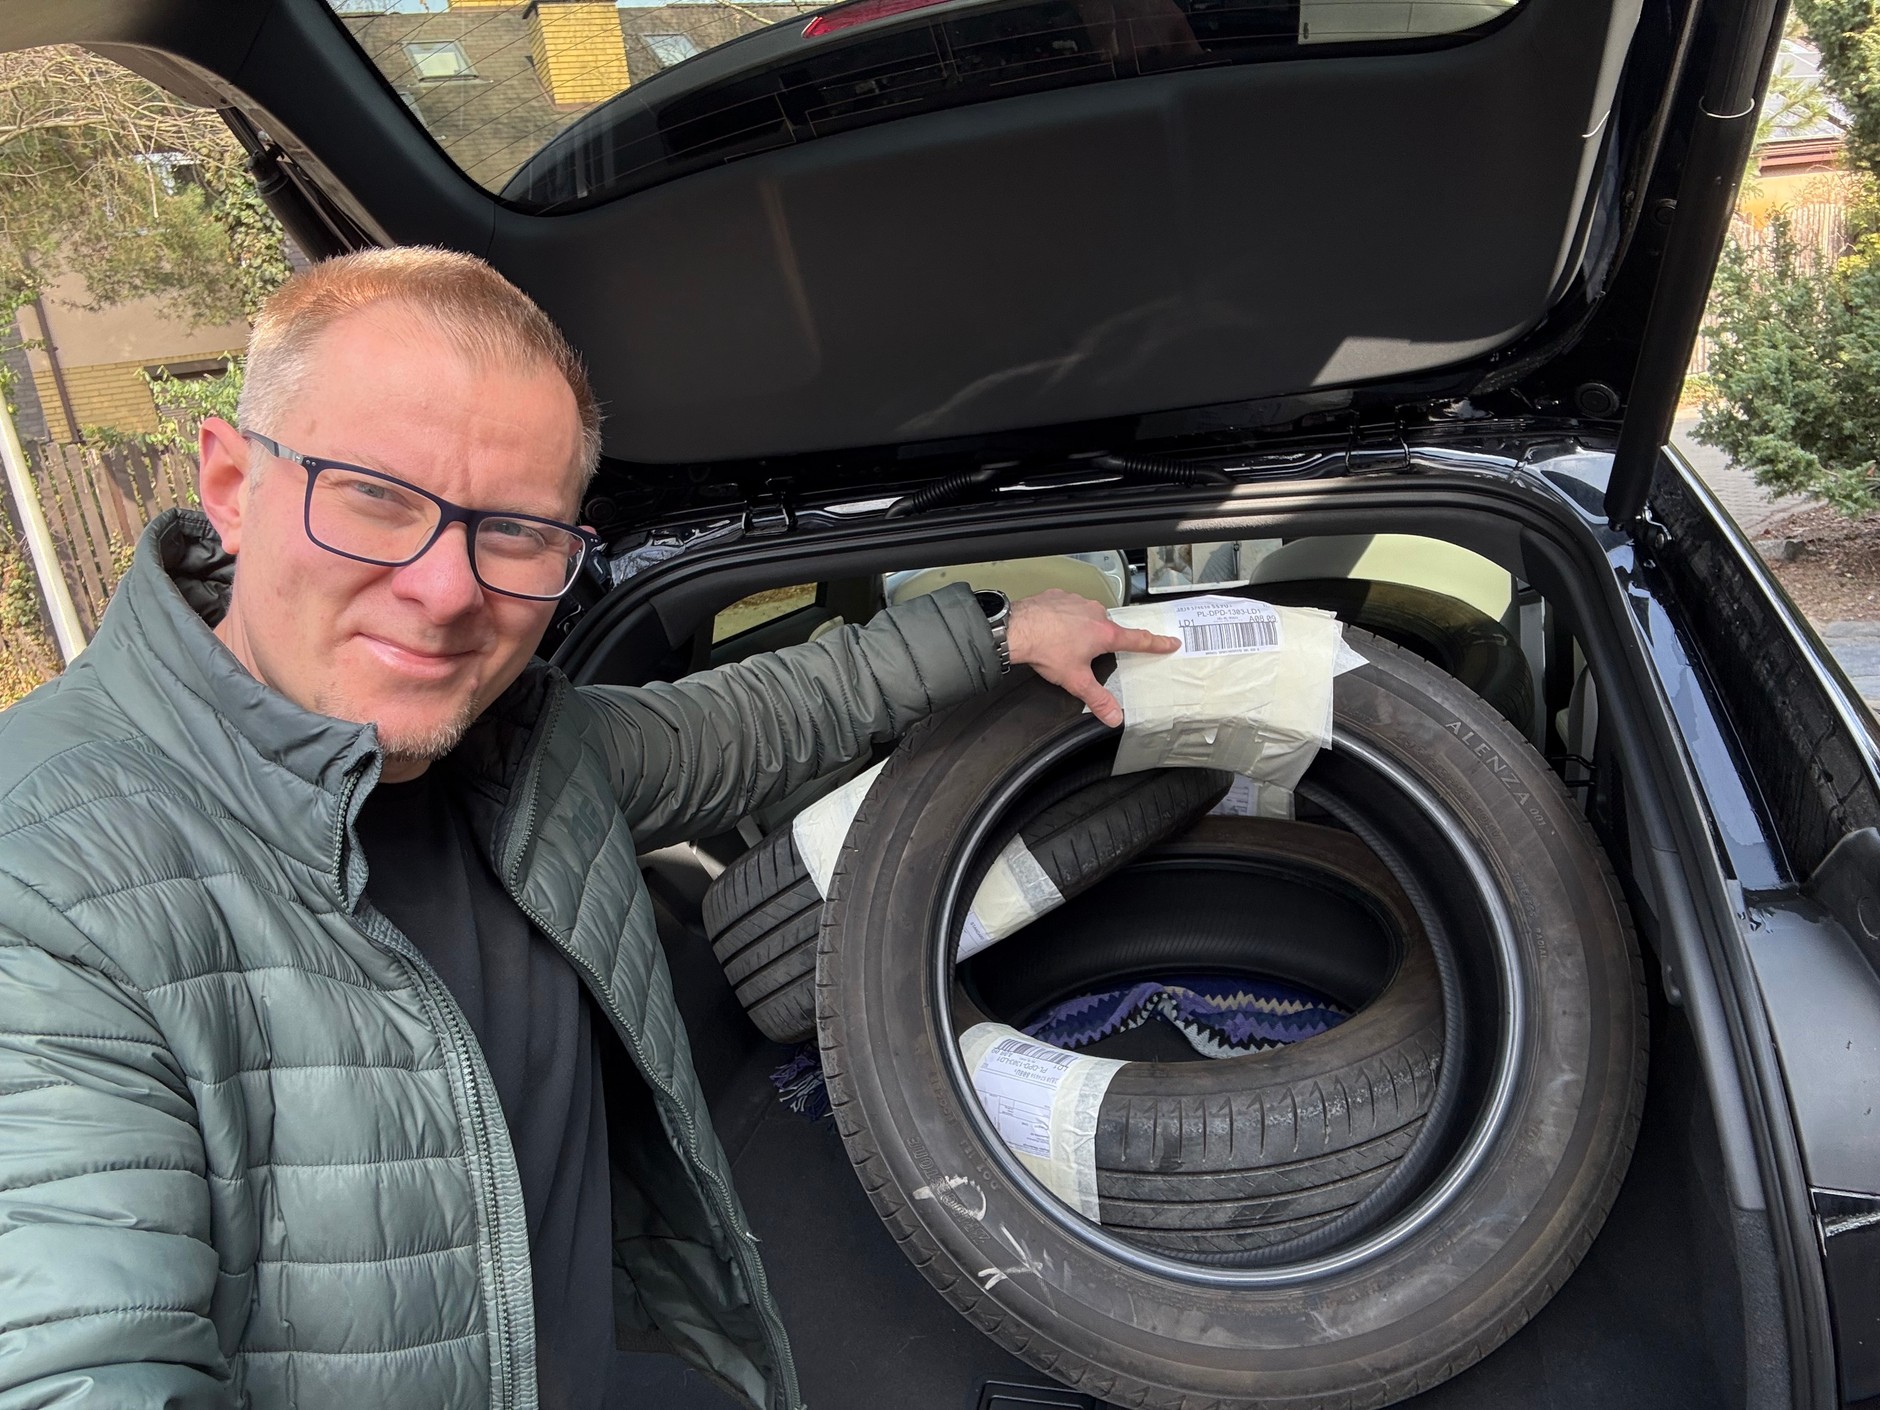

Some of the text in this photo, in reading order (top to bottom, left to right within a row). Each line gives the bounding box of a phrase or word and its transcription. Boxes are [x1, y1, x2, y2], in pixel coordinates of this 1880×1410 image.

[1178, 619, 1195, 628] LD1
[1445, 721, 1547, 827] ALENZA 001
